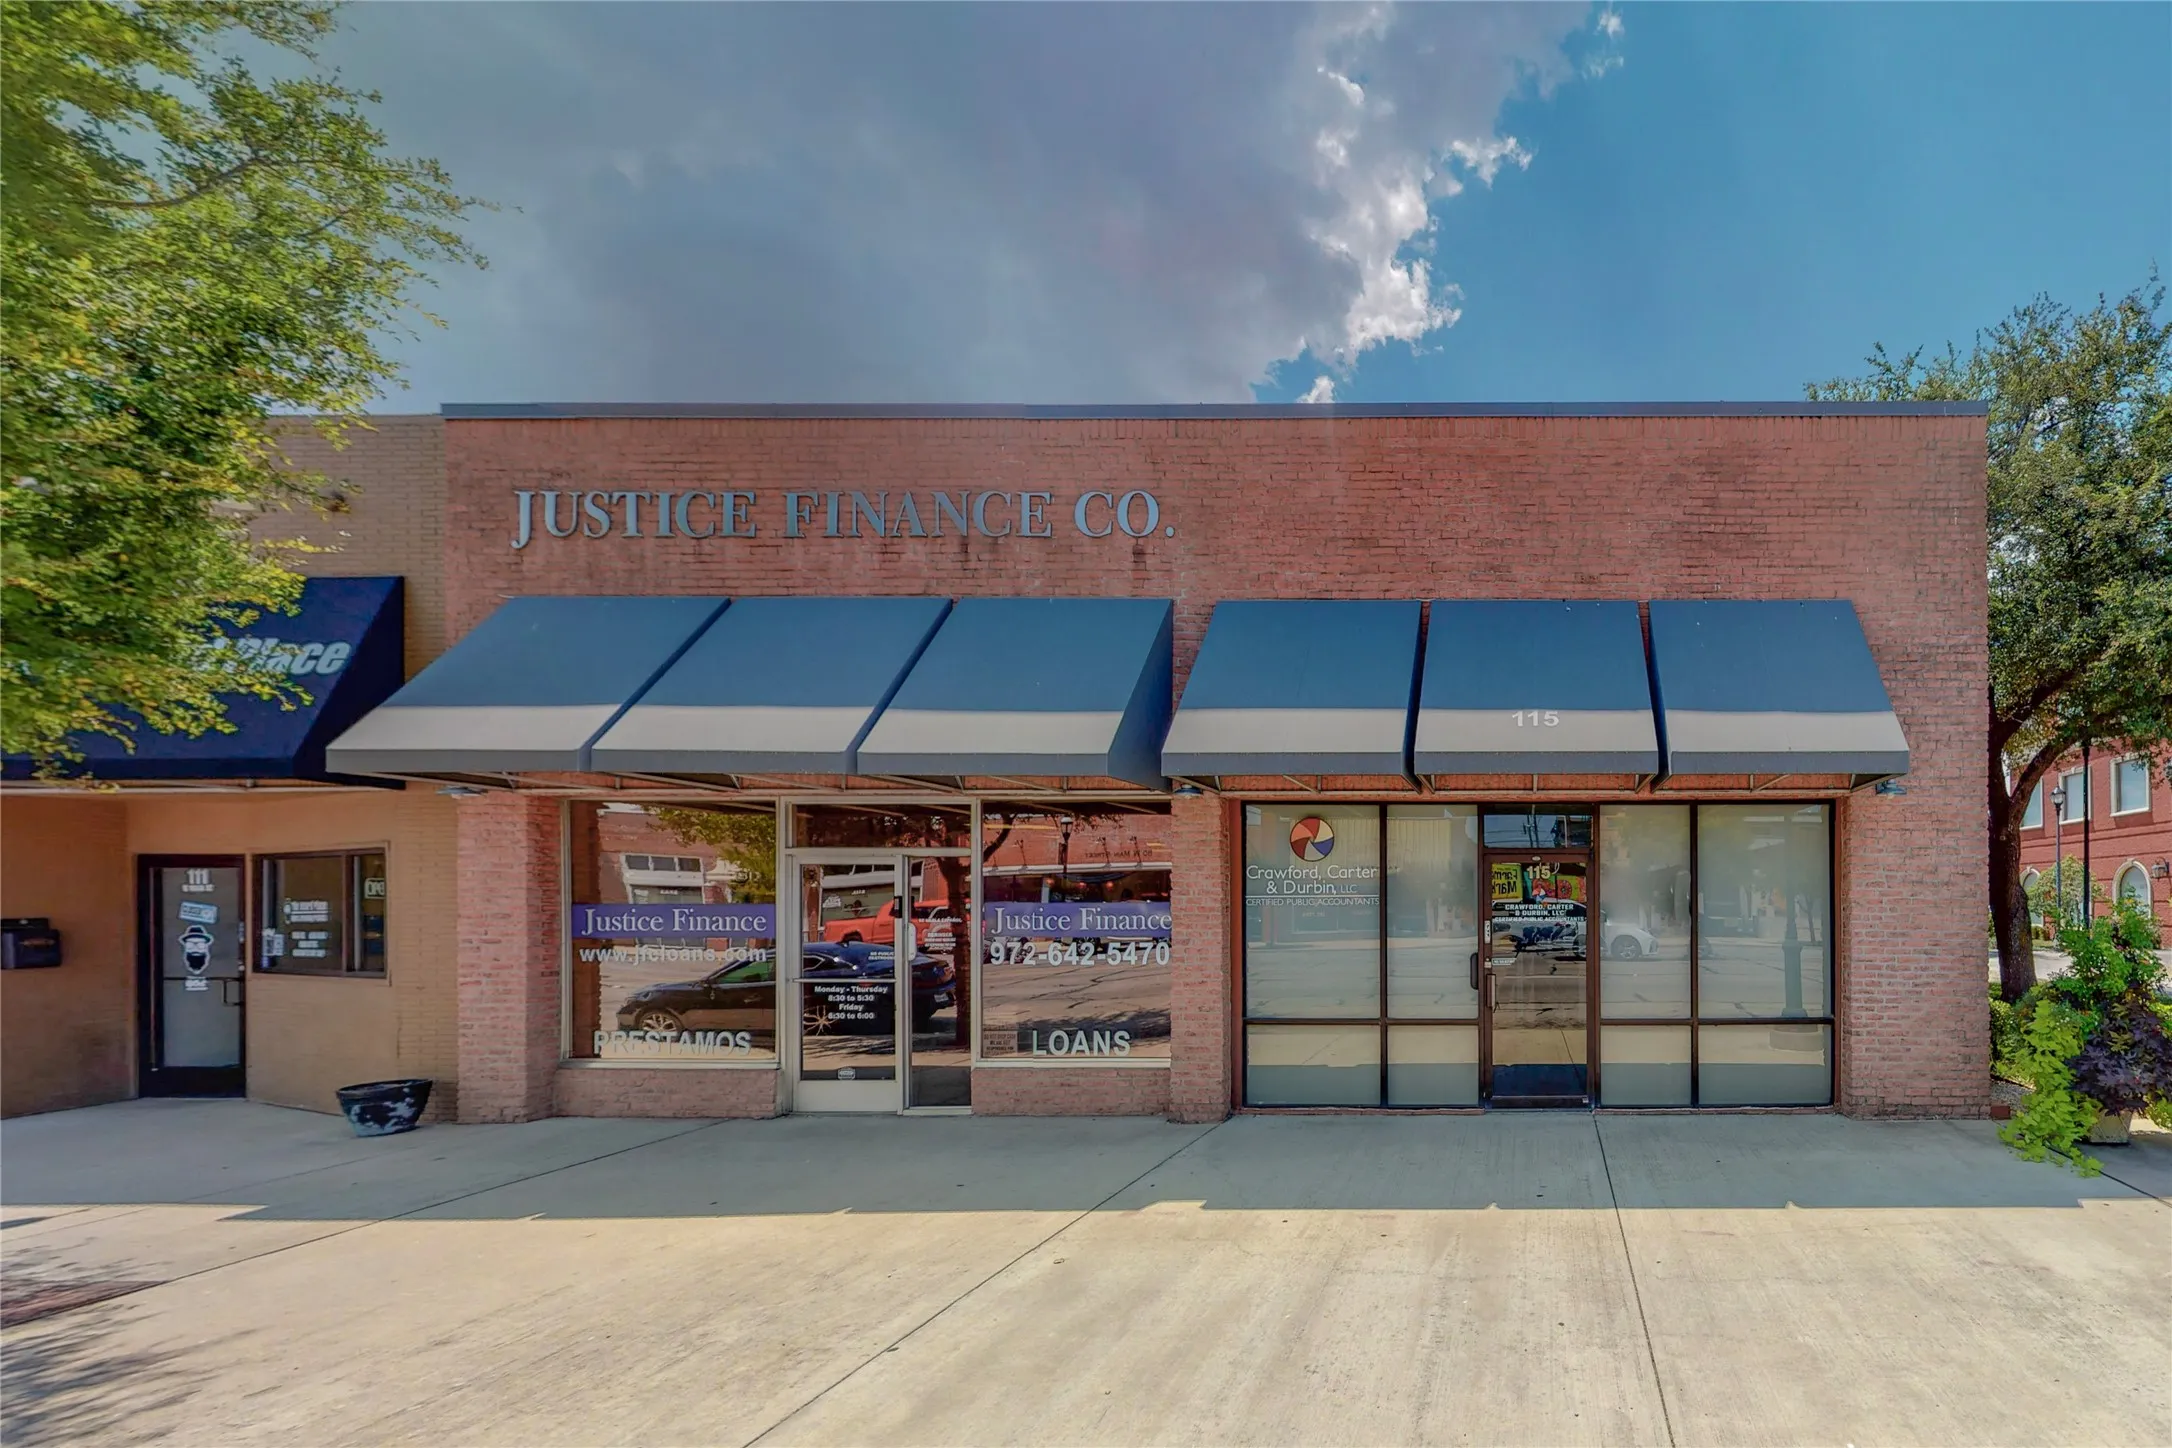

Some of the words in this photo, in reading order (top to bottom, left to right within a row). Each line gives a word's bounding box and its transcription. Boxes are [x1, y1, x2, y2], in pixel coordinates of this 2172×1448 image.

[511, 490, 756, 549] JUSTICE
[783, 490, 1052, 538] FINANCE
[1074, 489, 1175, 538] CO.
[1512, 710, 1559, 727] 115
[186, 868, 209, 885] 111
[1246, 865, 1322, 881] Crawford,
[1327, 865, 1378, 879] Carter
[1526, 866, 1551, 879] 115
[1266, 880, 1278, 894] &
[1283, 880, 1337, 895] Durbin,
[1340, 884, 1358, 894] LLC
[1246, 898, 1284, 906] CERTIFIED
[1286, 898, 1315, 906] PUBLIC
[1316, 898, 1380, 906] ACCOUNTANTS
[581, 908, 664, 936] Justice
[672, 908, 767, 932] Finance
[991, 907, 1071, 934] Justice
[1079, 907, 1172, 930] Finance
[990, 942, 1170, 966] 972-642-5470
[814, 985, 845, 994] Monday
[851, 985, 888, 994] Thursday
[839, 1004, 864, 1012] Friday
[593, 1030, 752, 1057] PRESTAMOS
[1032, 1030, 1131, 1057] LOANS
